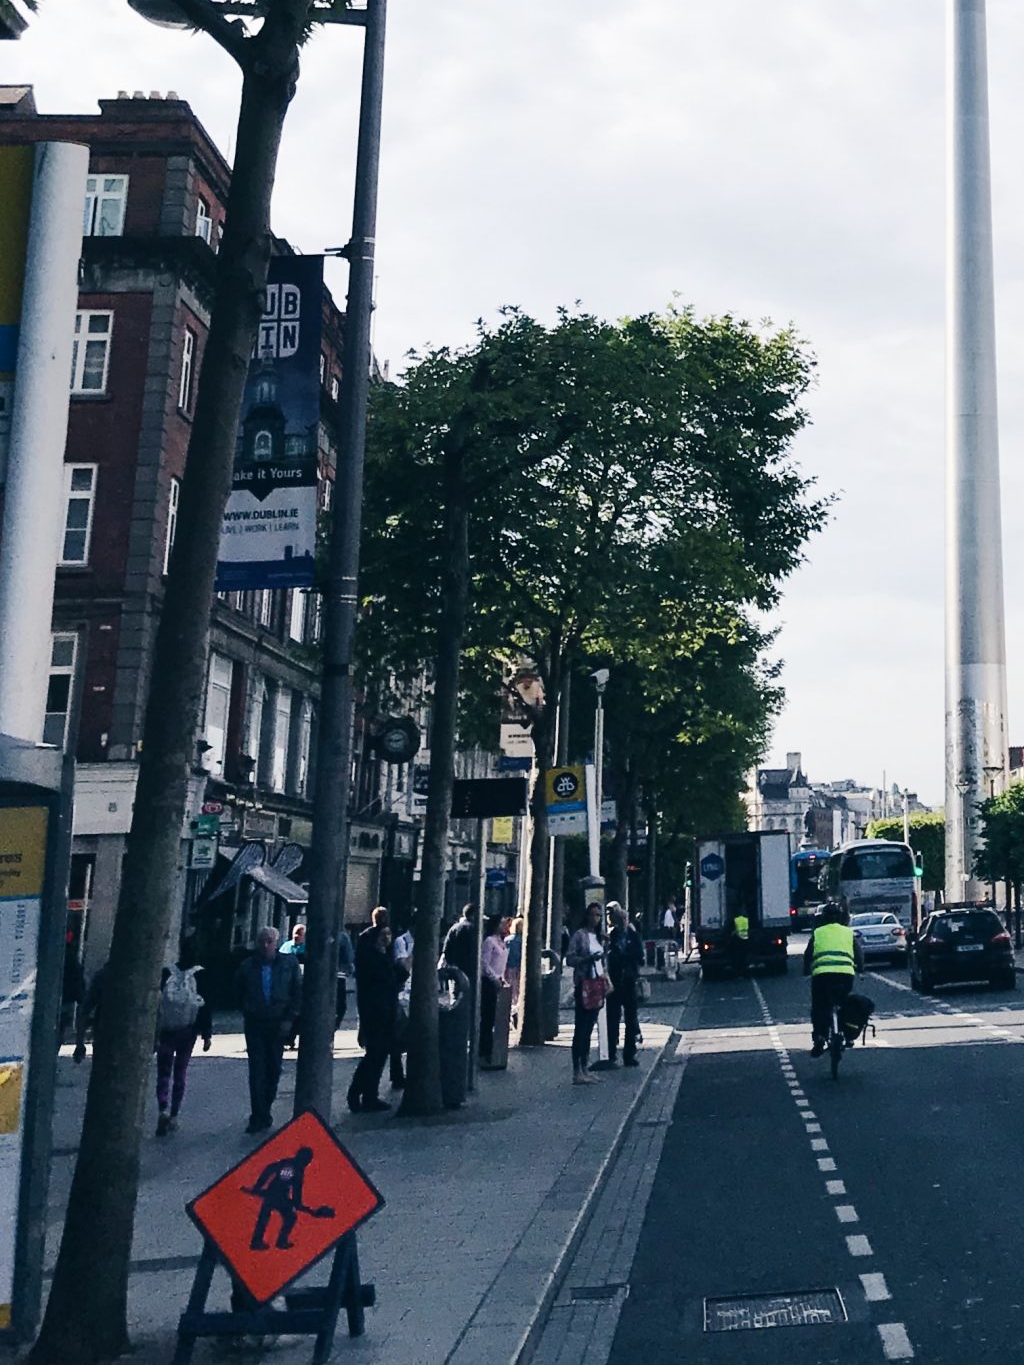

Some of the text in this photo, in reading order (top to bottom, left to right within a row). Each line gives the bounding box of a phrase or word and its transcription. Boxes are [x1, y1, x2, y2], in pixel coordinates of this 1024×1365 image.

[265, 291, 299, 316] UB
[260, 324, 298, 350] IN
[233, 467, 302, 481] ake it Yours
[223, 508, 299, 521] WWW.DUBLIN.IE
